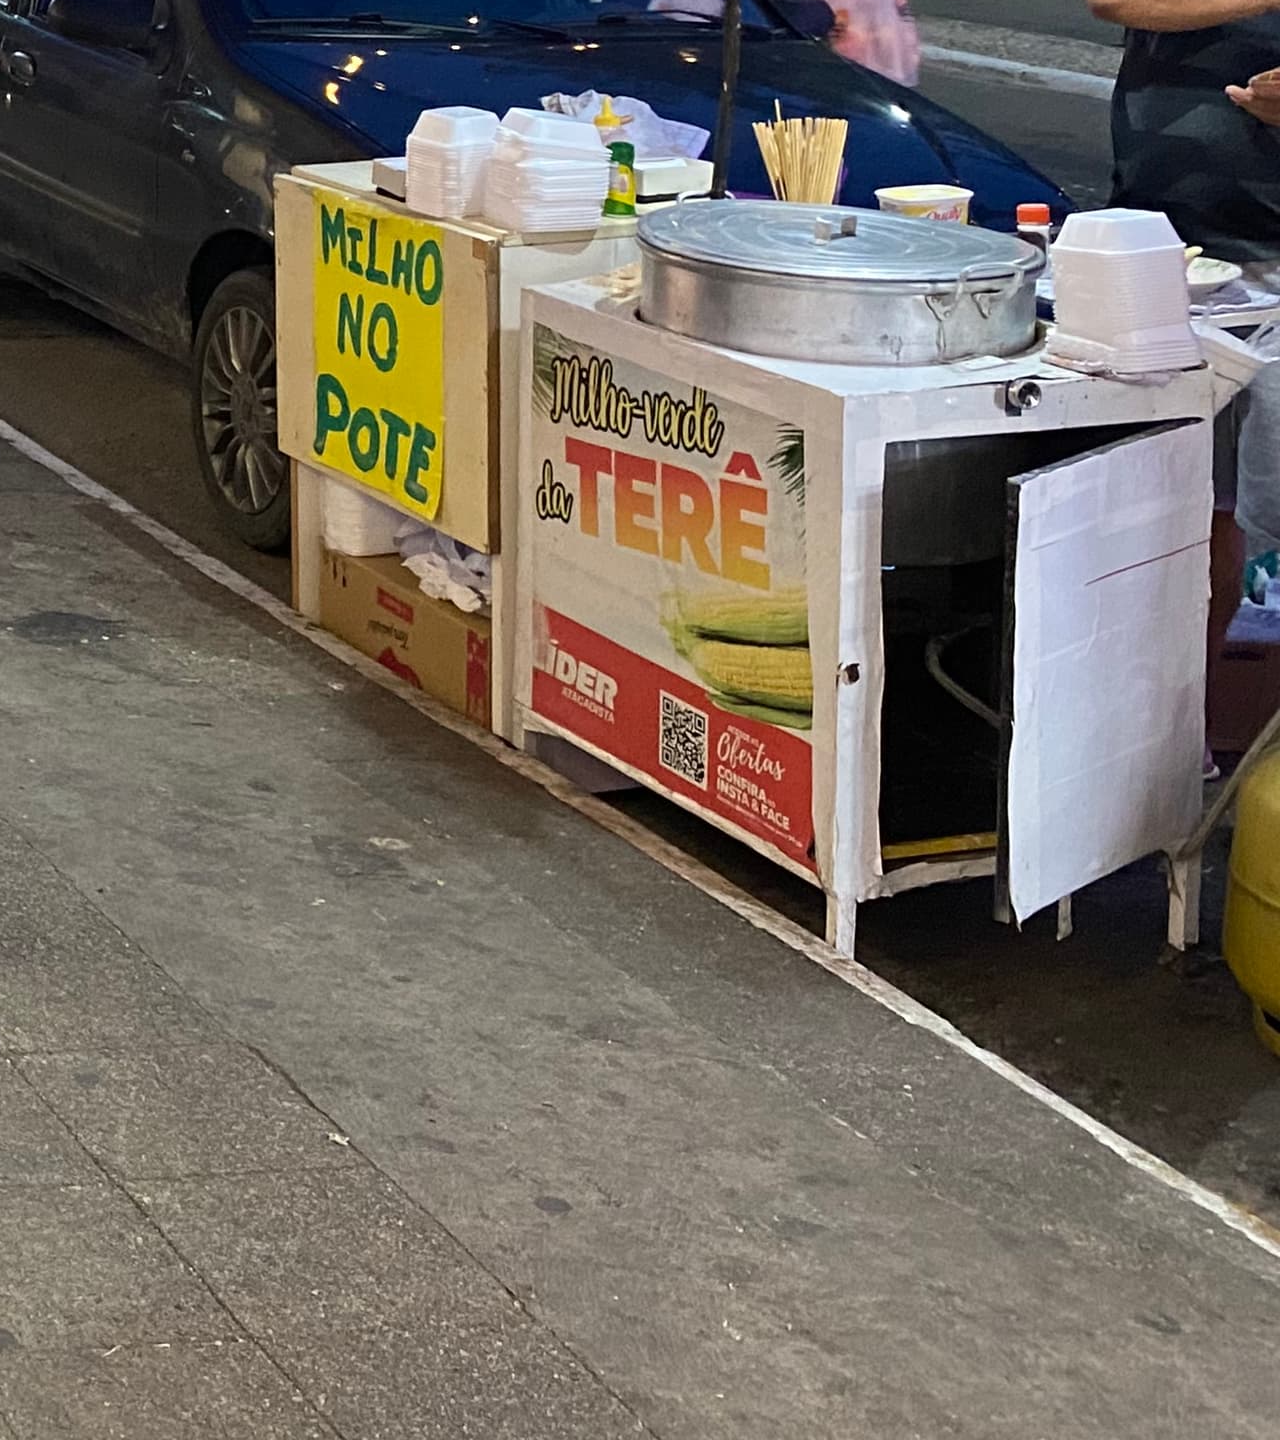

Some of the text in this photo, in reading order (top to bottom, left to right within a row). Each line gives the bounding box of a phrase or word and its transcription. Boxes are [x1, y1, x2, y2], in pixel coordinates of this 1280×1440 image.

[321, 203, 443, 306] MILHO
[337, 292, 398, 372] NO
[314, 373, 437, 505] POTE
[551, 356, 725, 456] Milho-verde
[537, 436, 771, 591] da TERÊ
[717, 732, 786, 781] Ofertas
[717, 765, 766, 801] CONFIRA
[716, 777, 750, 808] INSTA
[761, 803, 791, 831] FACE
